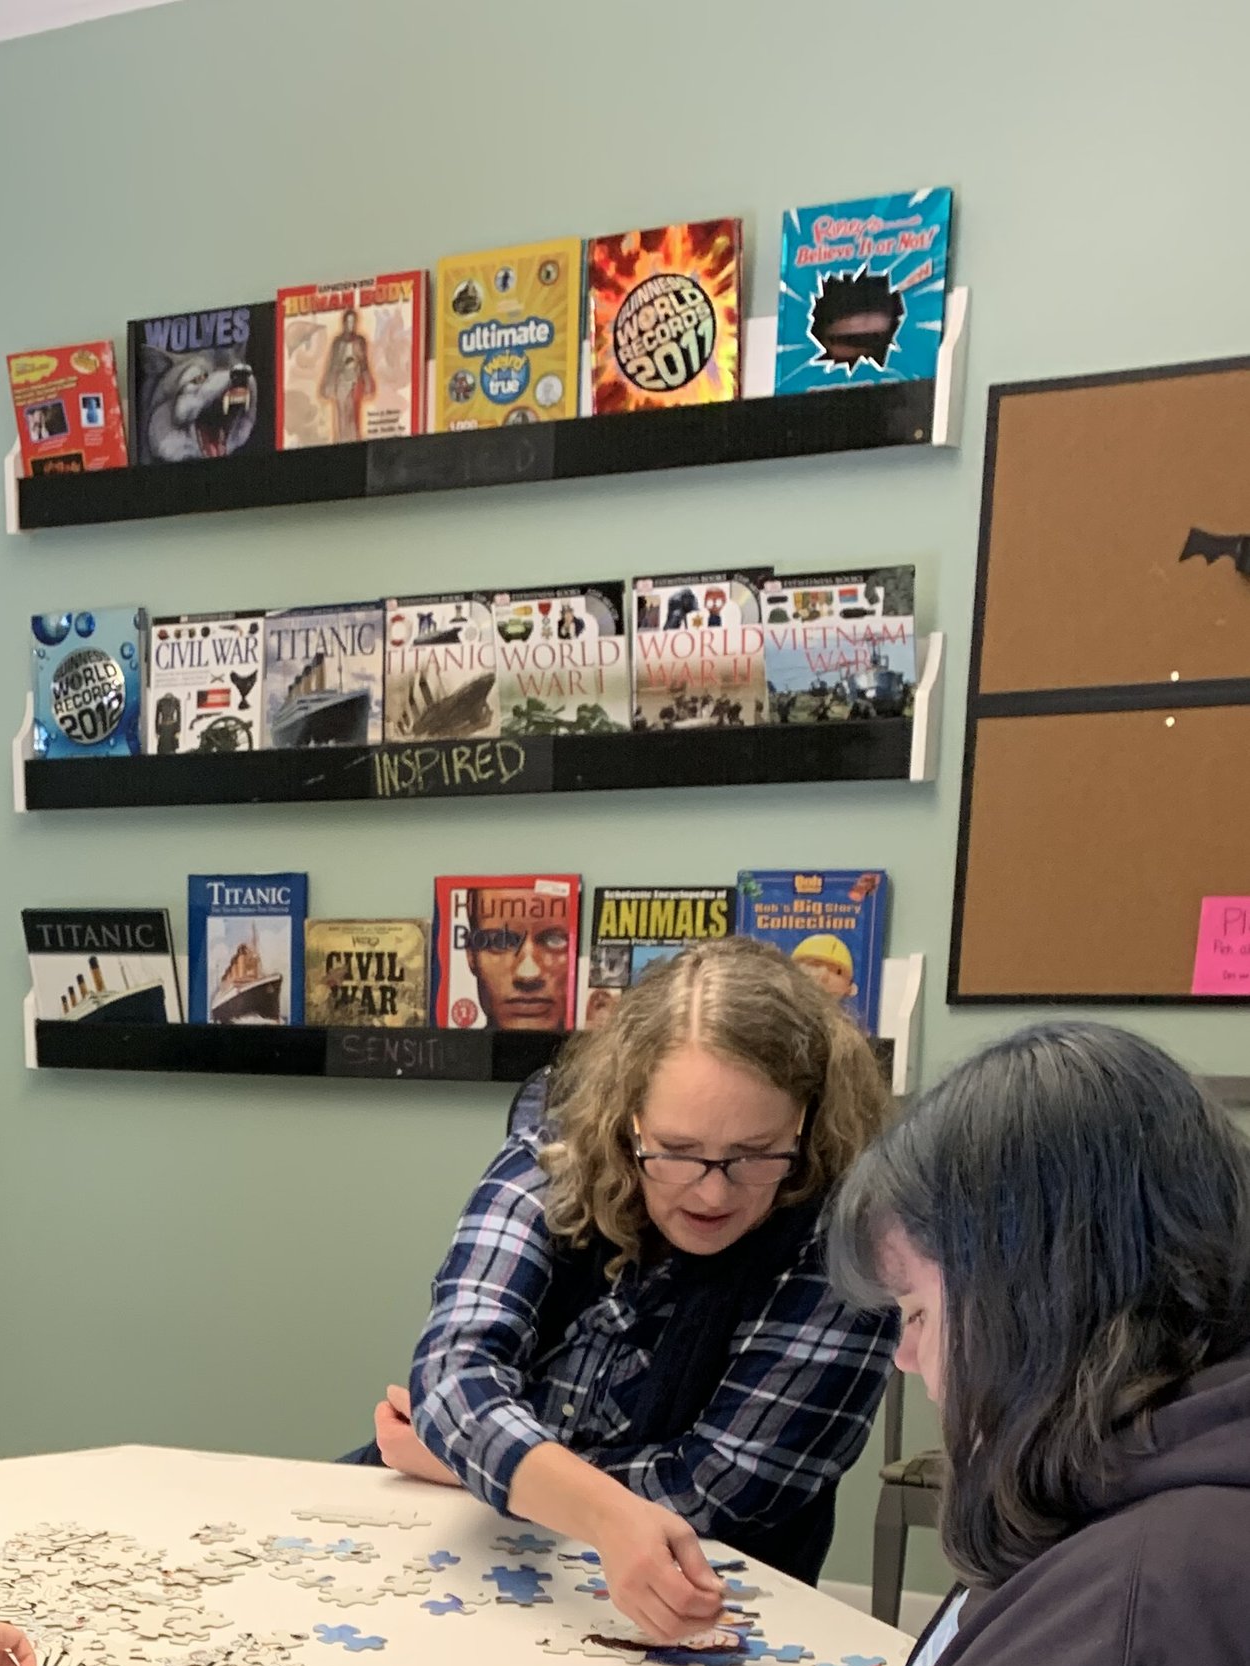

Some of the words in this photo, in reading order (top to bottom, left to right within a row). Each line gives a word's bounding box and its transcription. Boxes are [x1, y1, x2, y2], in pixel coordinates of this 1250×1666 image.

[796, 245, 853, 266] Believe
[875, 238, 895, 254] or
[284, 287, 355, 316] HUMAN
[359, 279, 415, 309] BODY
[144, 308, 250, 352] WOLVES
[616, 286, 705, 346] WORLD
[462, 320, 550, 352] ultimate
[618, 302, 711, 364] RECORDS
[626, 316, 714, 389] 2011
[489, 379, 520, 396] true
[155, 639, 209, 671] CIVIL
[212, 635, 258, 666] WAR
[270, 622, 376, 662] TITANIC
[637, 626, 764, 660] WORLD
[770, 623, 907, 651] VIETNAM
[387, 643, 496, 675] TITANIC
[501, 639, 620, 670] WORLD
[805, 649, 872, 673] WAR
[53, 663, 117, 700] WORLD
[517, 670, 586, 697] WAR
[646, 659, 719, 688] WAR
[59, 693, 123, 740] 2012
[375, 741, 525, 796] INSPIRED
[454, 893, 567, 918] Human
[598, 899, 728, 938] ANIMALS
[793, 899, 823, 915] Big
[36, 924, 155, 948] TITANIC
[756, 914, 857, 930] Collection
[453, 922, 528, 957] Body
[326, 951, 405, 982] CIVIL
[330, 984, 398, 1016] WAR
